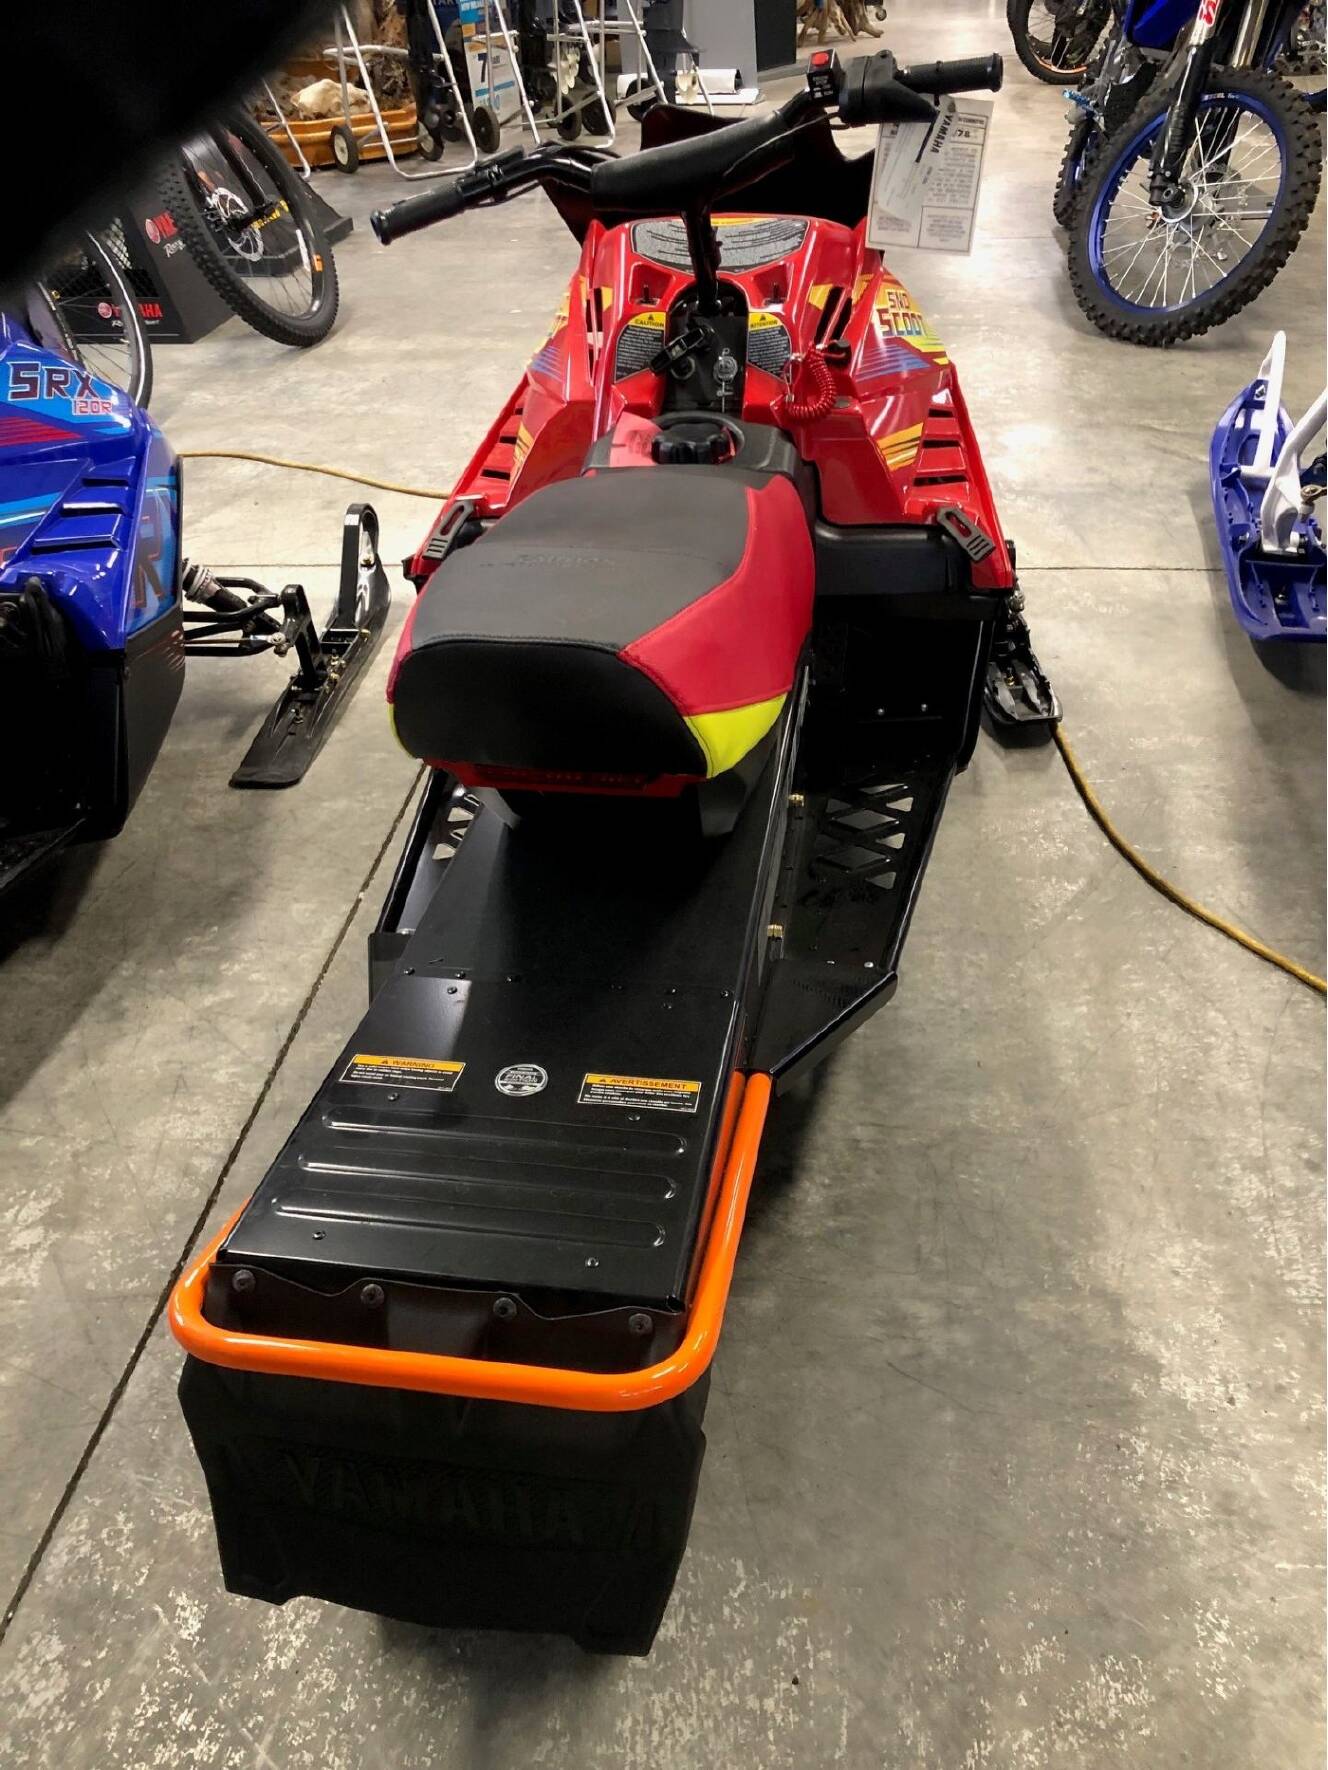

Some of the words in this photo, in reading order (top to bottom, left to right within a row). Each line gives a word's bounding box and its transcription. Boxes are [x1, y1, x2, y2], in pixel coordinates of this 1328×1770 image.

[7, 361, 101, 400] SRX
[72, 400, 113, 415] 120R
[392, 1059, 435, 1069] WARNING
[609, 1078, 688, 1090] AVERTISSEMENT
